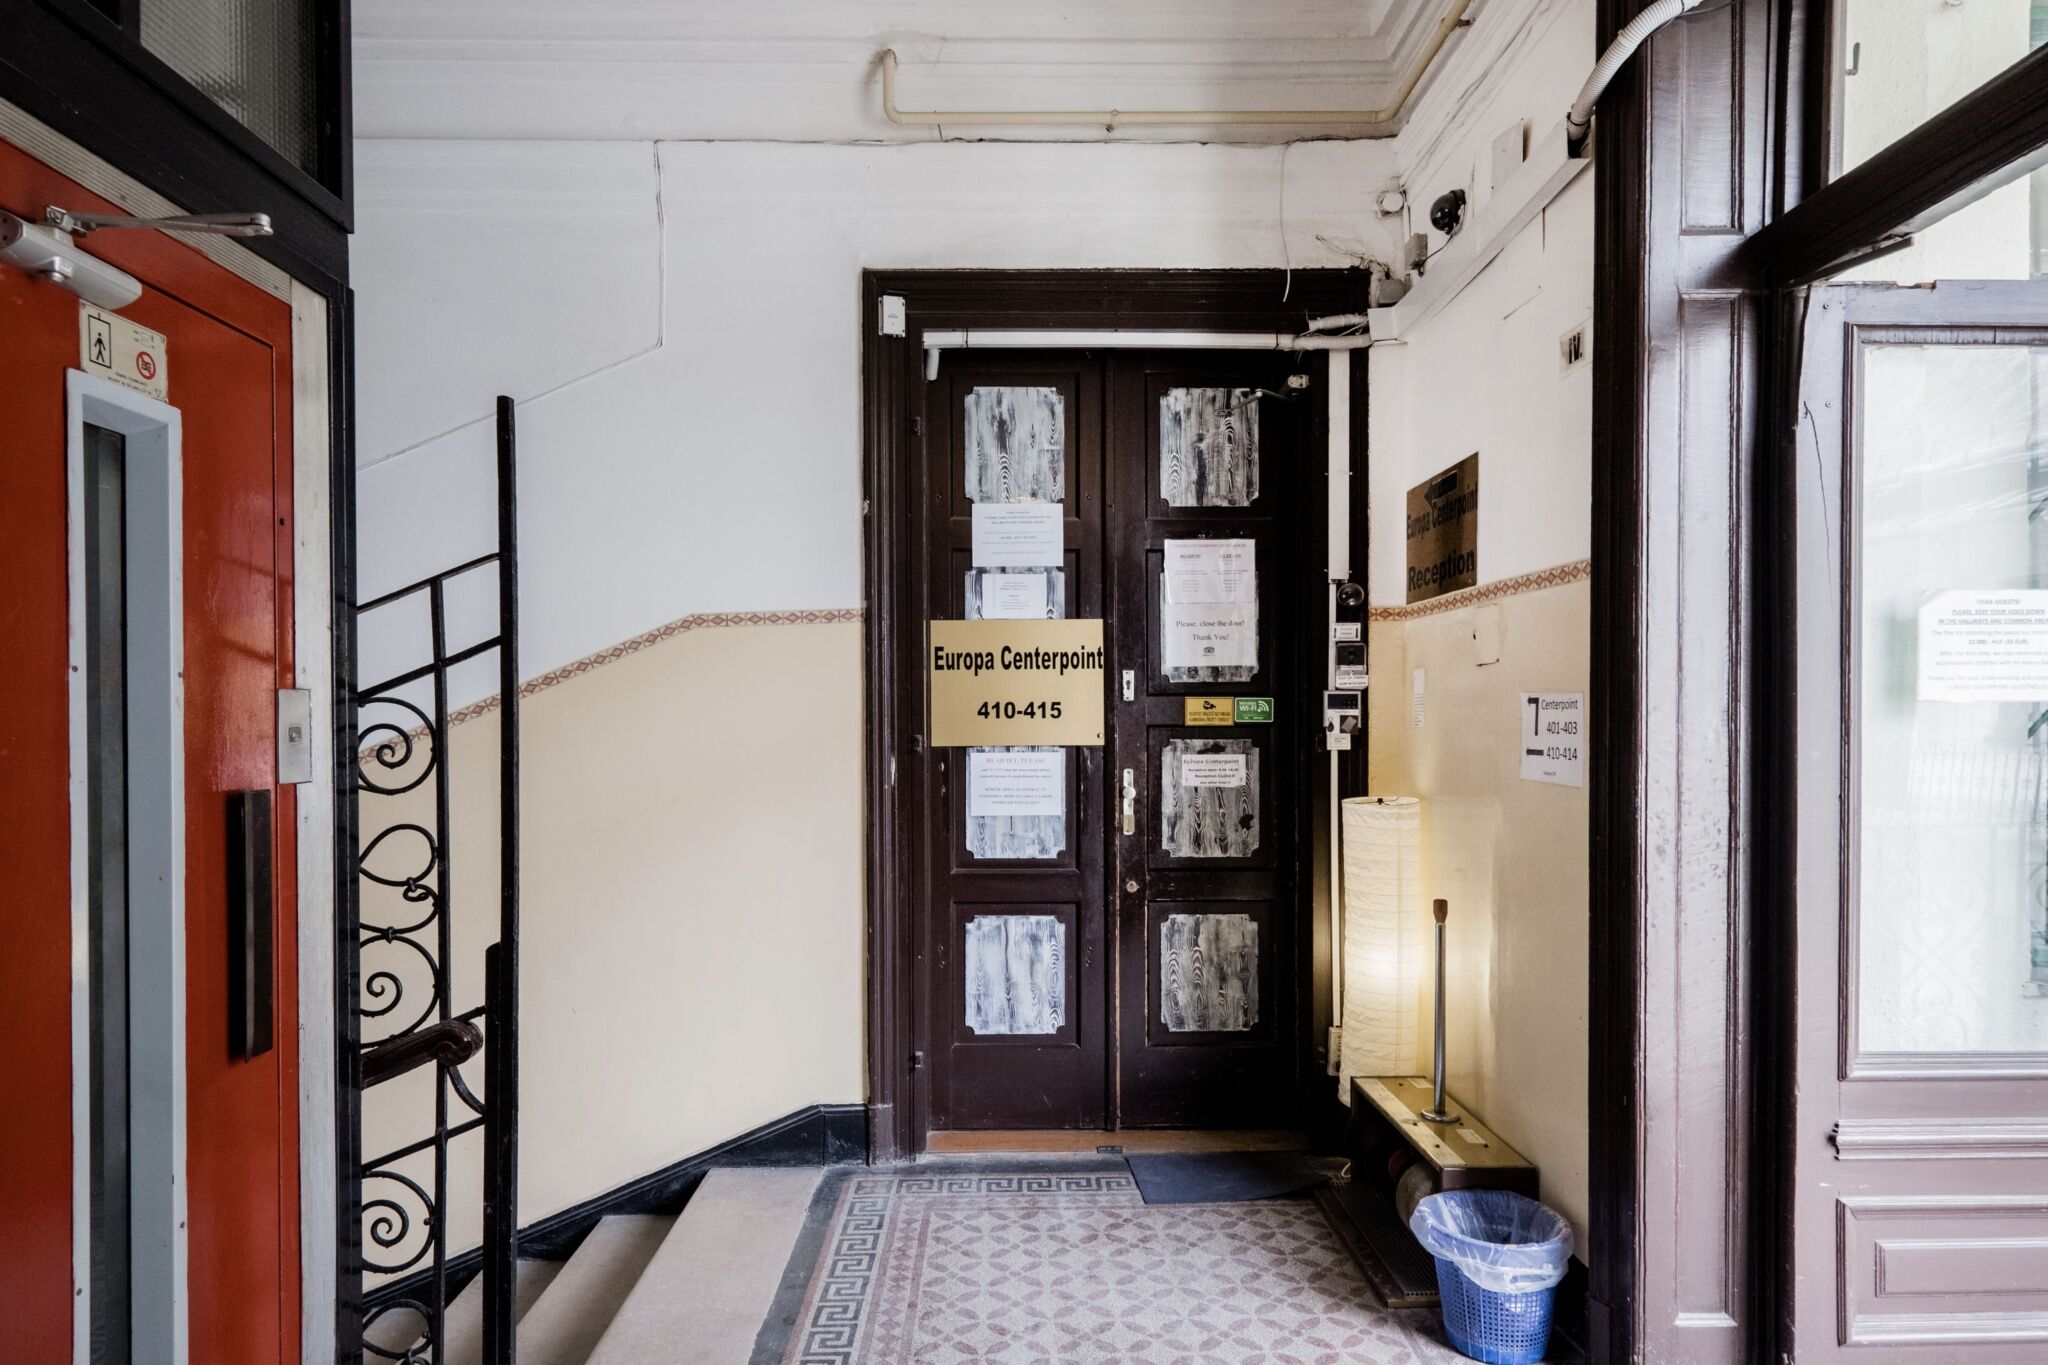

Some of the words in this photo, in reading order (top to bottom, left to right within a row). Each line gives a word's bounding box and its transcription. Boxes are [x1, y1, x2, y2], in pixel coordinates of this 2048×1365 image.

[1407, 511, 1431, 541] Europa
[1431, 480, 1479, 529] Centerpoint
[1408, 549, 1476, 592] Reception
[1199, 620, 1216, 628] close
[1217, 620, 1227, 628] the
[934, 646, 994, 677] Europa
[1001, 645, 1103, 676] Centerpoint
[977, 700, 1063, 720] 410-415
[1541, 698, 1579, 711] Centerpoint
[1546, 721, 1578, 735] 401-403
[1546, 746, 1578, 761] 410-414
